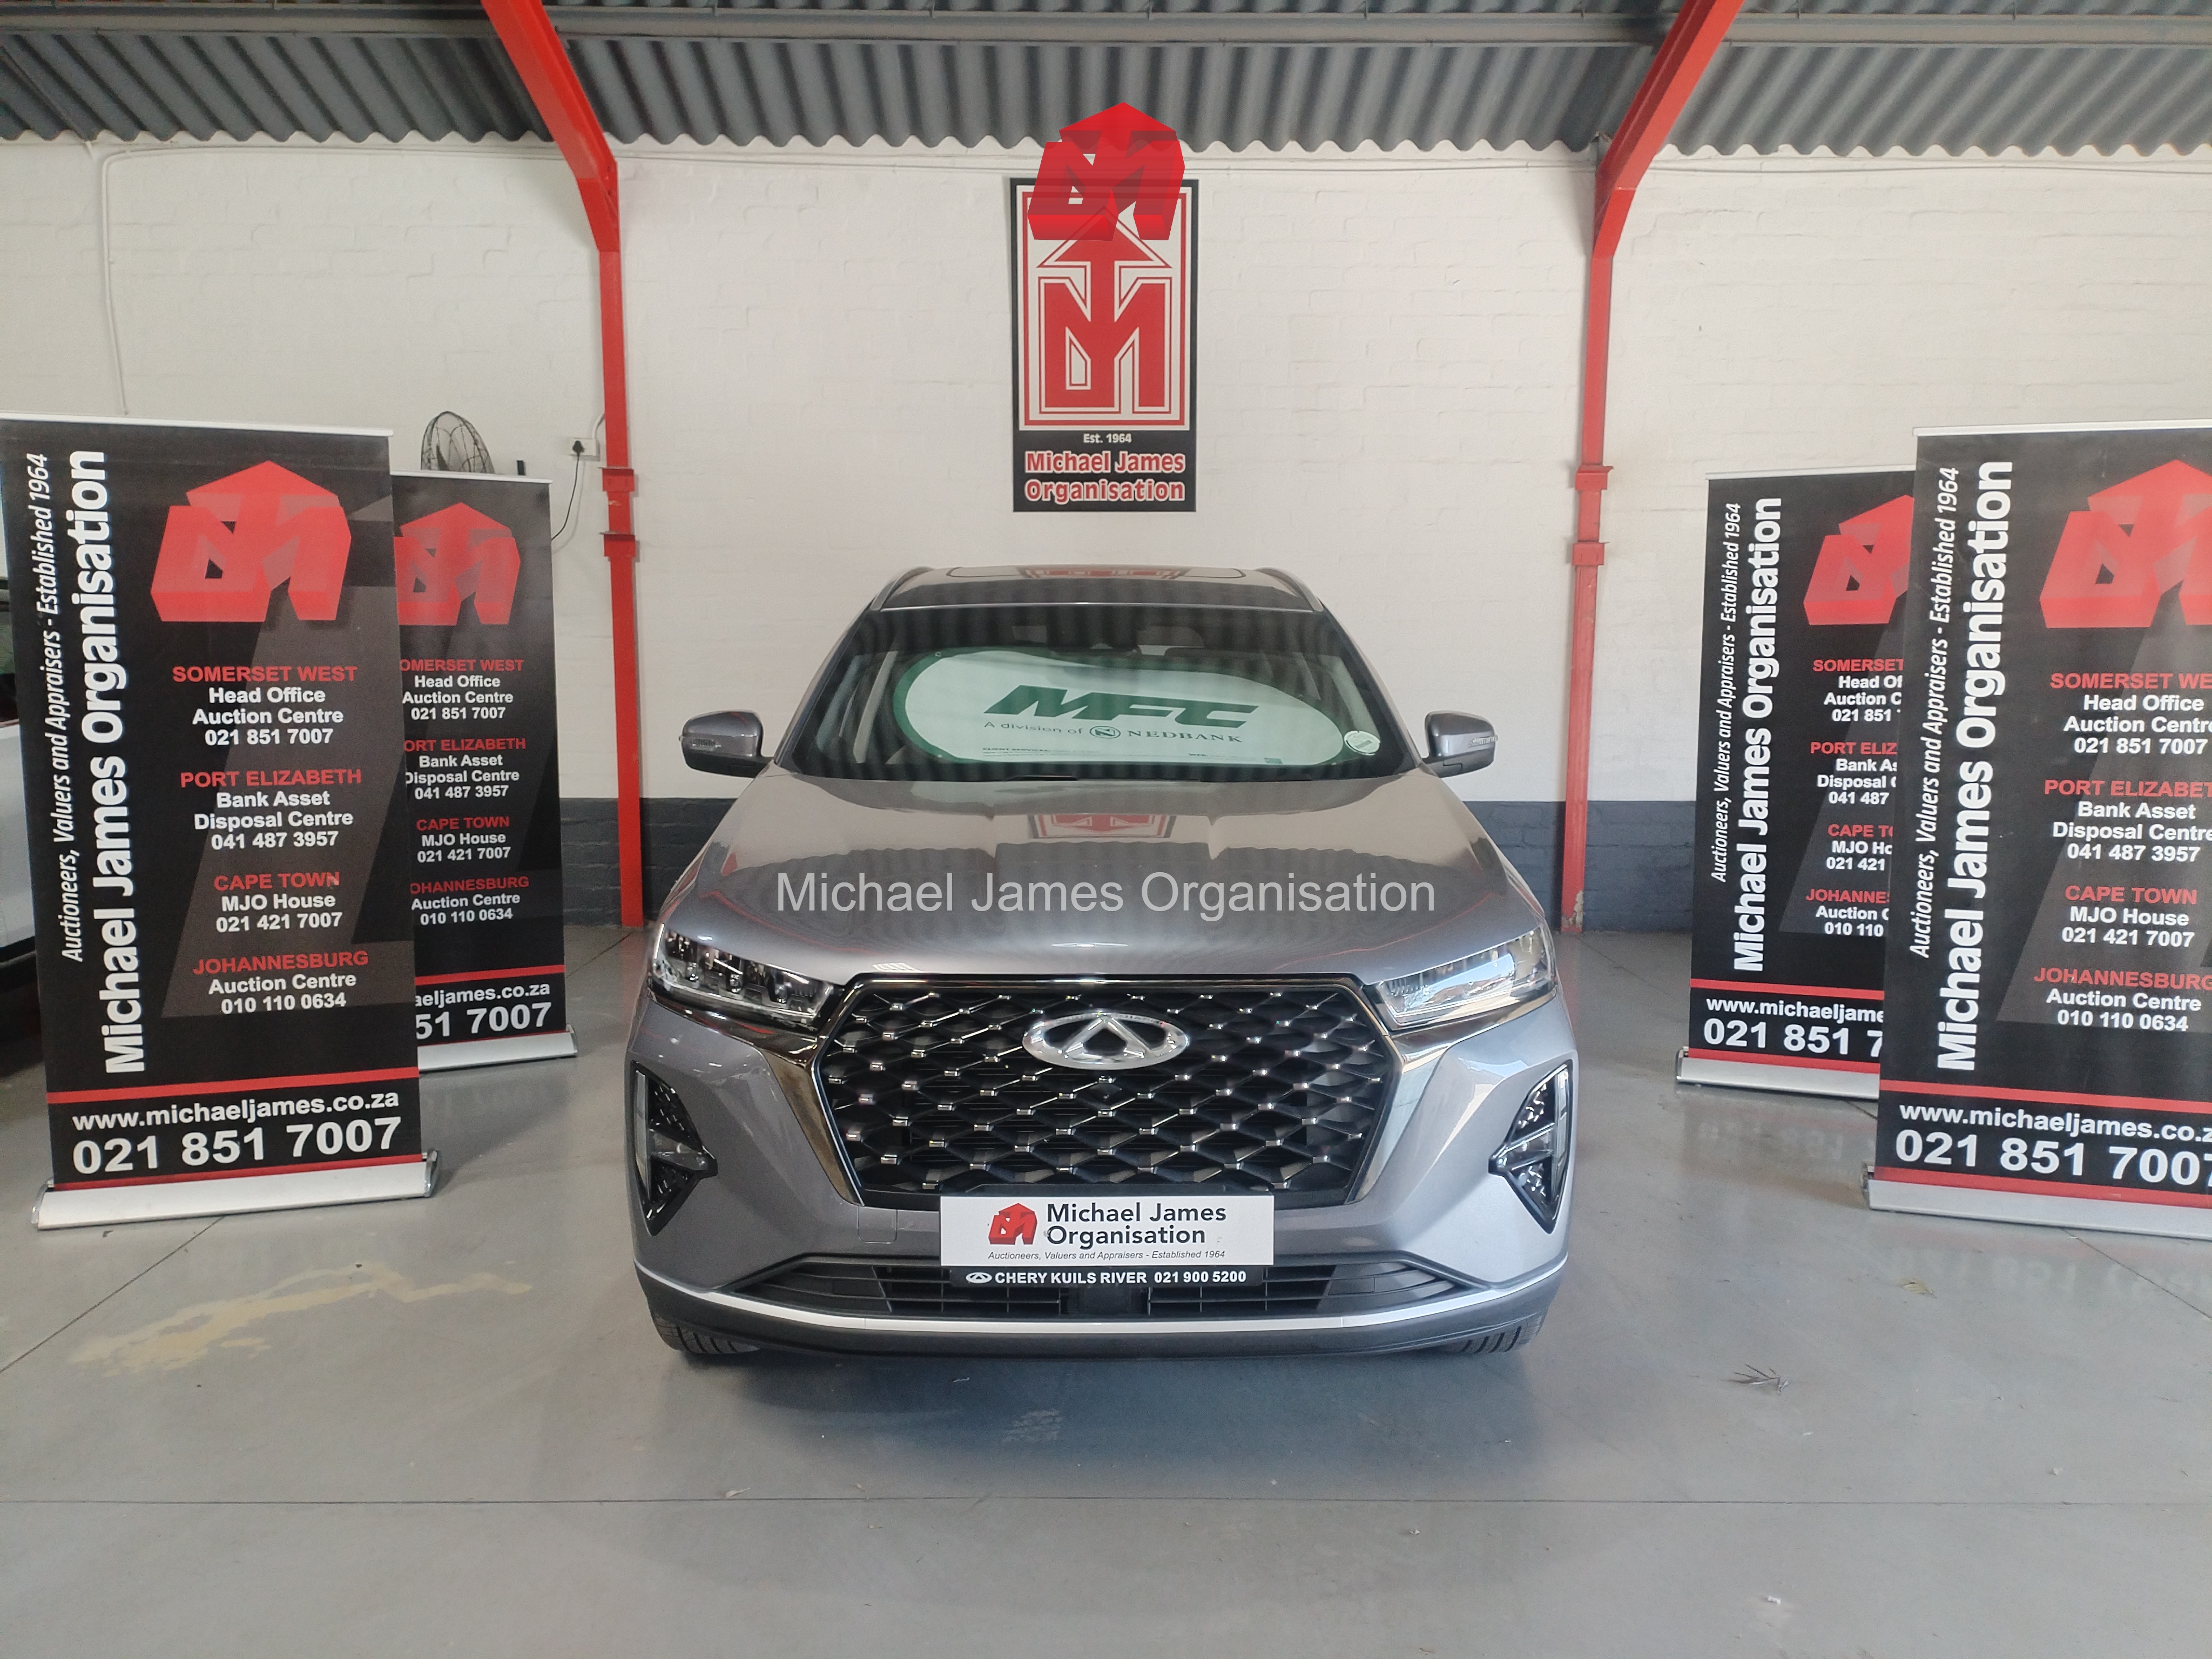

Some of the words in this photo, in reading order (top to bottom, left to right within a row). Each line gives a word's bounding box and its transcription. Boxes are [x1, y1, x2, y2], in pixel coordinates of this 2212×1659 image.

[1084, 434, 1103, 443] Est.
[1107, 434, 1131, 443] 1964
[1025, 450, 1111, 473] Michael
[1115, 450, 1186, 473] James
[26, 454, 50, 500] 1964
[1025, 478, 1185, 505] Organisation
[1937, 468, 1959, 512] 1964
[1725, 503, 1741, 538] 1964
[28, 505, 58, 614] Established
[1930, 518, 1955, 623] Established
[1721, 542, 1739, 622] Established
[66, 451, 126, 743] Organisation
[1956, 462, 2012, 747] Organisation
[1743, 498, 1781, 718] Organisation
[173, 666, 292, 682] SOMERSET
[297, 666, 358, 681] WEST
[480, 659, 524, 671] WEST
[1717, 634, 1736, 708] Appraisers
[40, 631, 70, 730] Appraisers
[415, 675, 453, 687] Head
[457, 675, 500, 687] Office
[1839, 676, 1879, 688] Head
[1923, 639, 1948, 734] Appraisers
[2051, 673, 2174, 689] SOMERSET
[209, 687, 261, 703] Head
[267, 687, 325, 703] Office
[402, 691, 460, 704] Auction
[466, 691, 513, 703] Centre
[1824, 692, 1886, 705] Auction
[2084, 694, 2136, 711] Head
[2143, 694, 2204, 711] Office
[193, 709, 272, 724] Auction
[278, 708, 343, 723] Centre
[412, 707, 436, 720] 021
[442, 707, 466, 719] 851
[472, 707, 505, 719] 7007
[984, 685, 1259, 728] MFC
[1001, 723, 1061, 733] division
[1128, 731, 1242, 743] NEDBANK
[1716, 710, 1731, 737] and
[2063, 716, 2144, 732] Auction
[205, 729, 239, 745] 021
[247, 729, 280, 744] 851
[287, 729, 333, 744] 7007
[441, 738, 525, 751] ELIZABETH
[2074, 738, 2108, 753] 021
[2116, 738, 2150, 753] 851
[2160, 739, 2208, 754] 7007
[45, 733, 69, 770] and
[1811, 742, 1857, 754] PORT
[1920, 737, 1941, 773] and
[420, 755, 457, 767] Bank
[461, 755, 503, 766] Asset
[1714, 741, 1730, 791] Valuers
[1836, 759, 1877, 771] Bank
[181, 771, 240, 787] PORT
[246, 769, 361, 786] ELIZABETH
[406, 770, 467, 786] Disposal
[471, 770, 519, 781] Centre
[1738, 729, 1771, 835] James
[1817, 775, 1886, 790] Disposal
[2045, 780, 2105, 795] PORT
[51, 774, 74, 842] Valuers
[217, 792, 269, 808] Bank
[273, 791, 330, 806] Asset
[1916, 777, 1939, 841] Valuers
[2078, 801, 2130, 818] Bank
[2135, 802, 2196, 819] Asset
[90, 757, 133, 896] James
[195, 812, 282, 832] Disposal
[288, 811, 353, 826] Centre
[416, 818, 459, 831] CAPE
[463, 816, 509, 828] TOWN
[1828, 824, 1874, 837] CAPE
[1947, 761, 1993, 898] James
[2053, 822, 2143, 841] Disposal
[212, 834, 244, 849] 041
[253, 832, 287, 848] 487
[293, 831, 338, 847] 3957
[422, 834, 455, 846] MJO
[460, 833, 505, 845] House
[1711, 798, 1731, 882] Auctioneers,
[1832, 841, 1868, 854] MJO
[2067, 844, 2101, 859] 041
[2109, 845, 2146, 860] 487
[2152, 846, 2201, 862] 3957
[214, 874, 272, 891] CAPE
[278, 872, 339, 888] TOWN
[222, 894, 267, 911] MJO
[274, 894, 335, 909] House
[412, 896, 468, 910] Auction
[473, 893, 520, 906] Centre
[1910, 850, 1939, 958] Auctioneers,
[2066, 886, 2125, 902] CAPE
[2132, 888, 2197, 905] TOWN
[58, 850, 83, 962] Auctioneers,
[1734, 844, 1766, 971] Michael
[1816, 906, 1877, 920] Auction
[2071, 906, 2116, 923] MJO
[2123, 908, 2190, 926] House
[217, 916, 249, 932] 021
[257, 914, 289, 929] 421
[297, 912, 342, 928] 7007
[2062, 927, 2095, 943] 021
[2103, 929, 2137, 945] 421
[2147, 930, 2195, 947] 7007
[193, 950, 368, 974] JOHANNESBURG
[94, 908, 144, 1073] Michael
[209, 976, 286, 994] Auction
[292, 973, 356, 989] Centre
[1938, 909, 1984, 1070] Michael
[221, 997, 256, 1014] 010
[263, 995, 295, 1011] 110
[301, 993, 346, 1009] 0634
[2046, 988, 2126, 1007] Auction
[2133, 993, 2201, 1011] Centre
[467, 1002, 551, 1033] 7007
[2058, 1010, 2093, 1026] 010
[2100, 1012, 2134, 1028] 110
[2140, 1014, 2189, 1031] 0634
[1704, 1019, 1766, 1048] 021
[1784, 1024, 1848, 1054] 851
[72, 1091, 400, 1131] www.michaeljames.co.za
[1899, 1104, 2212, 1144] www.michaeljames.co.z
[73, 1136, 157, 1174] 021
[182, 1128, 263, 1165] 851
[287, 1117, 401, 1157] 7007
[1896, 1130, 1977, 1166] 021
[2000, 1138, 2083, 1176] 851
[1048, 1202, 1140, 1222] Michael
[1150, 1203, 1226, 1221] James
[1047, 1225, 1204, 1250] Organisation
[988, 1252, 1041, 1260] Auctioneers,
[1097, 1251, 1143, 1260] Appraisers
[995, 1272, 1047, 1283] CHERY
[1051, 1272, 1096, 1283] KUILS
[1101, 1272, 1147, 1283] RIVER
[1155, 1272, 1178, 1283] 021
[1183, 1271, 1209, 1283] 900
[1213, 1271, 1246, 1282] 5200
